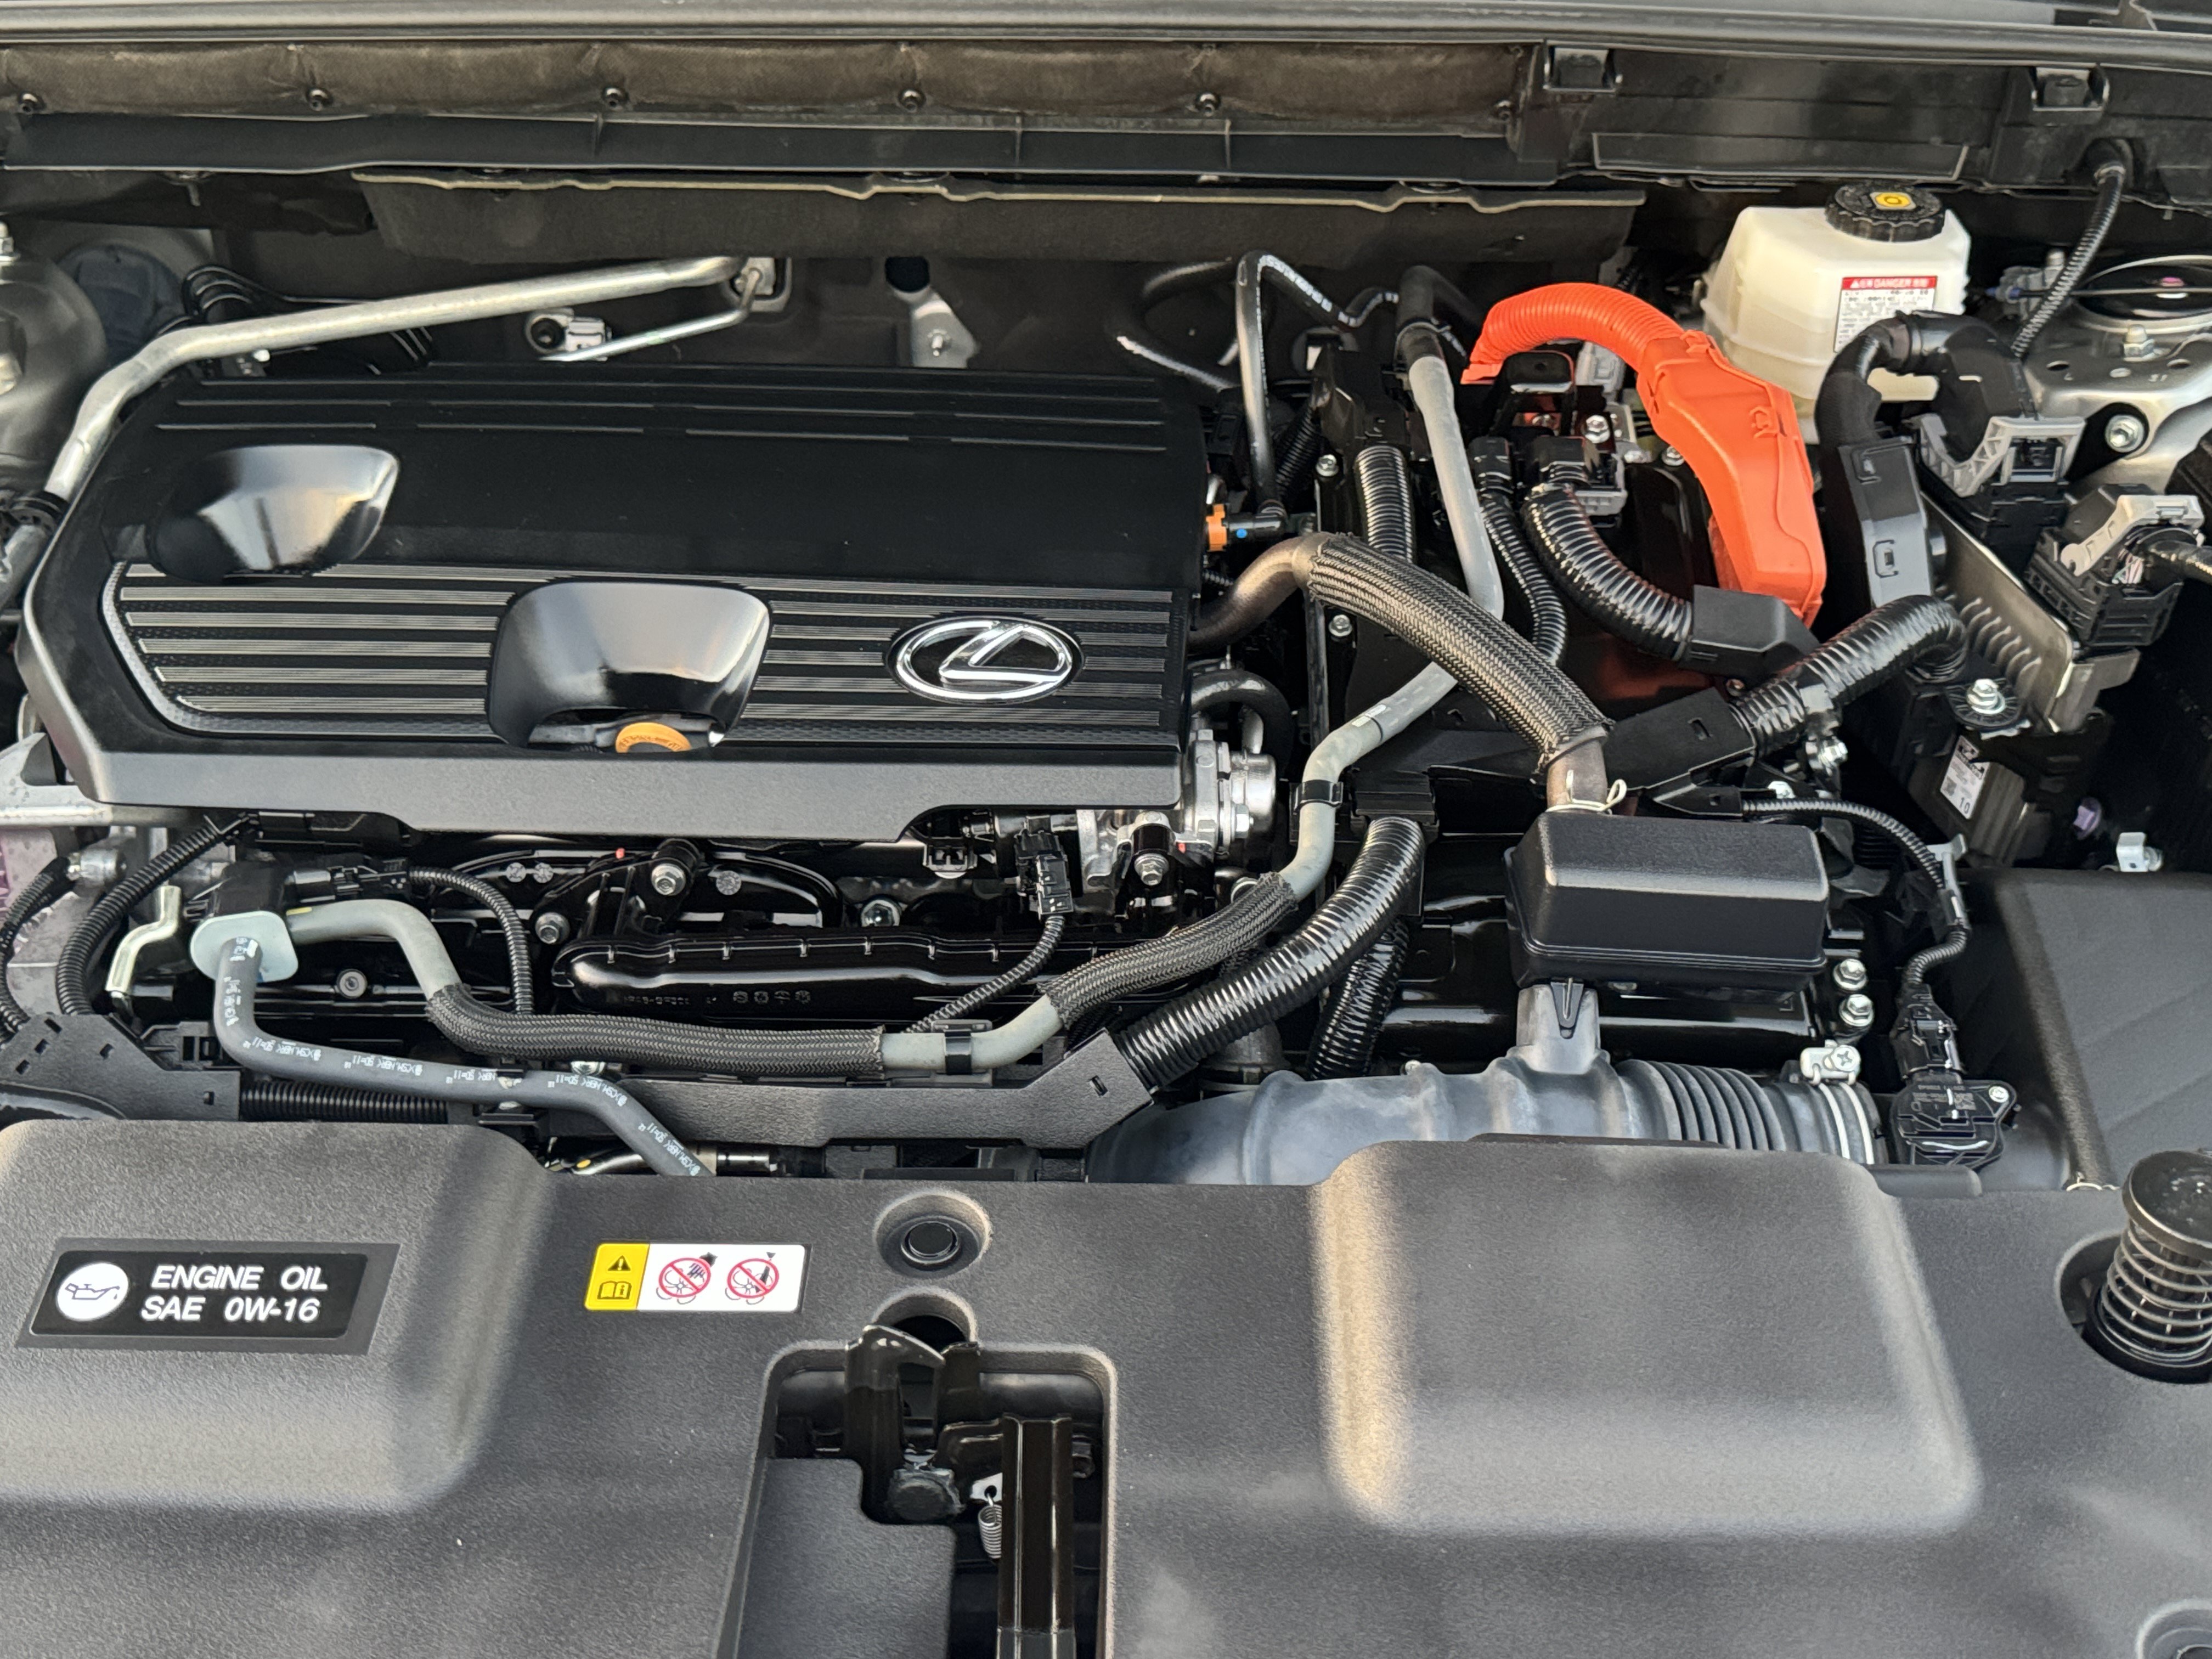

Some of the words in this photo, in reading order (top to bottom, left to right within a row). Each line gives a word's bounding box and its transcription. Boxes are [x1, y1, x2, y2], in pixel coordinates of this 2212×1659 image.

[1959, 797, 1971, 814] 10
[151, 1265, 264, 1290] ENGINE
[281, 1266, 327, 1290] OIL
[142, 1295, 206, 1321] SAE
[224, 1297, 320, 1322] 0W-16
